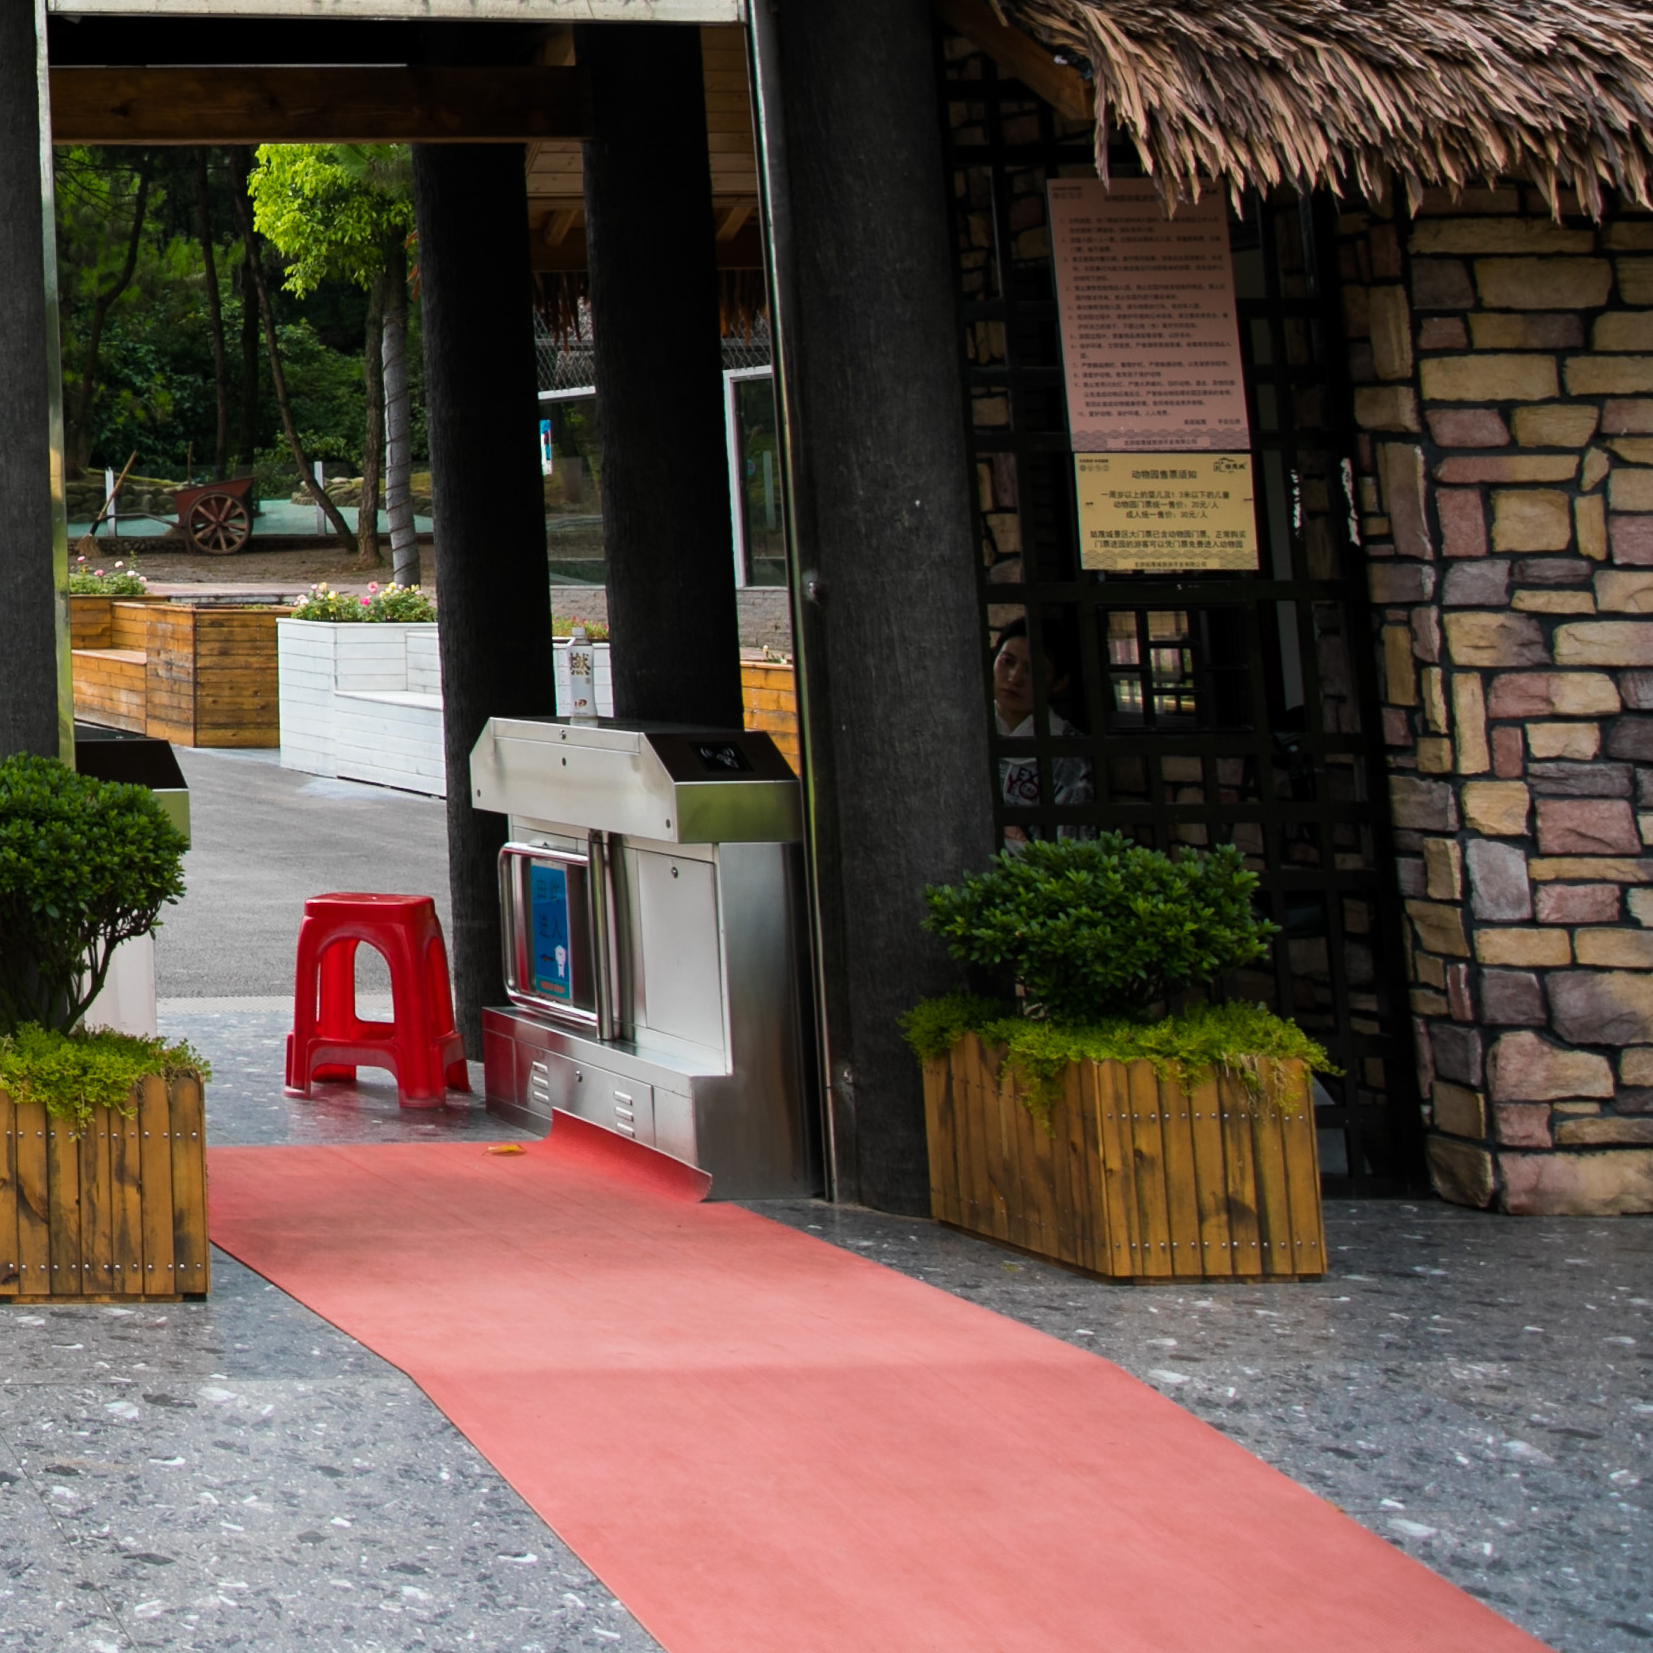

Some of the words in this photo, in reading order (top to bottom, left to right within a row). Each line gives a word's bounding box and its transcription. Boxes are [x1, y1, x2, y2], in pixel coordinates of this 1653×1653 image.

[1131, 469, 1197, 479] 动物园售票须知
